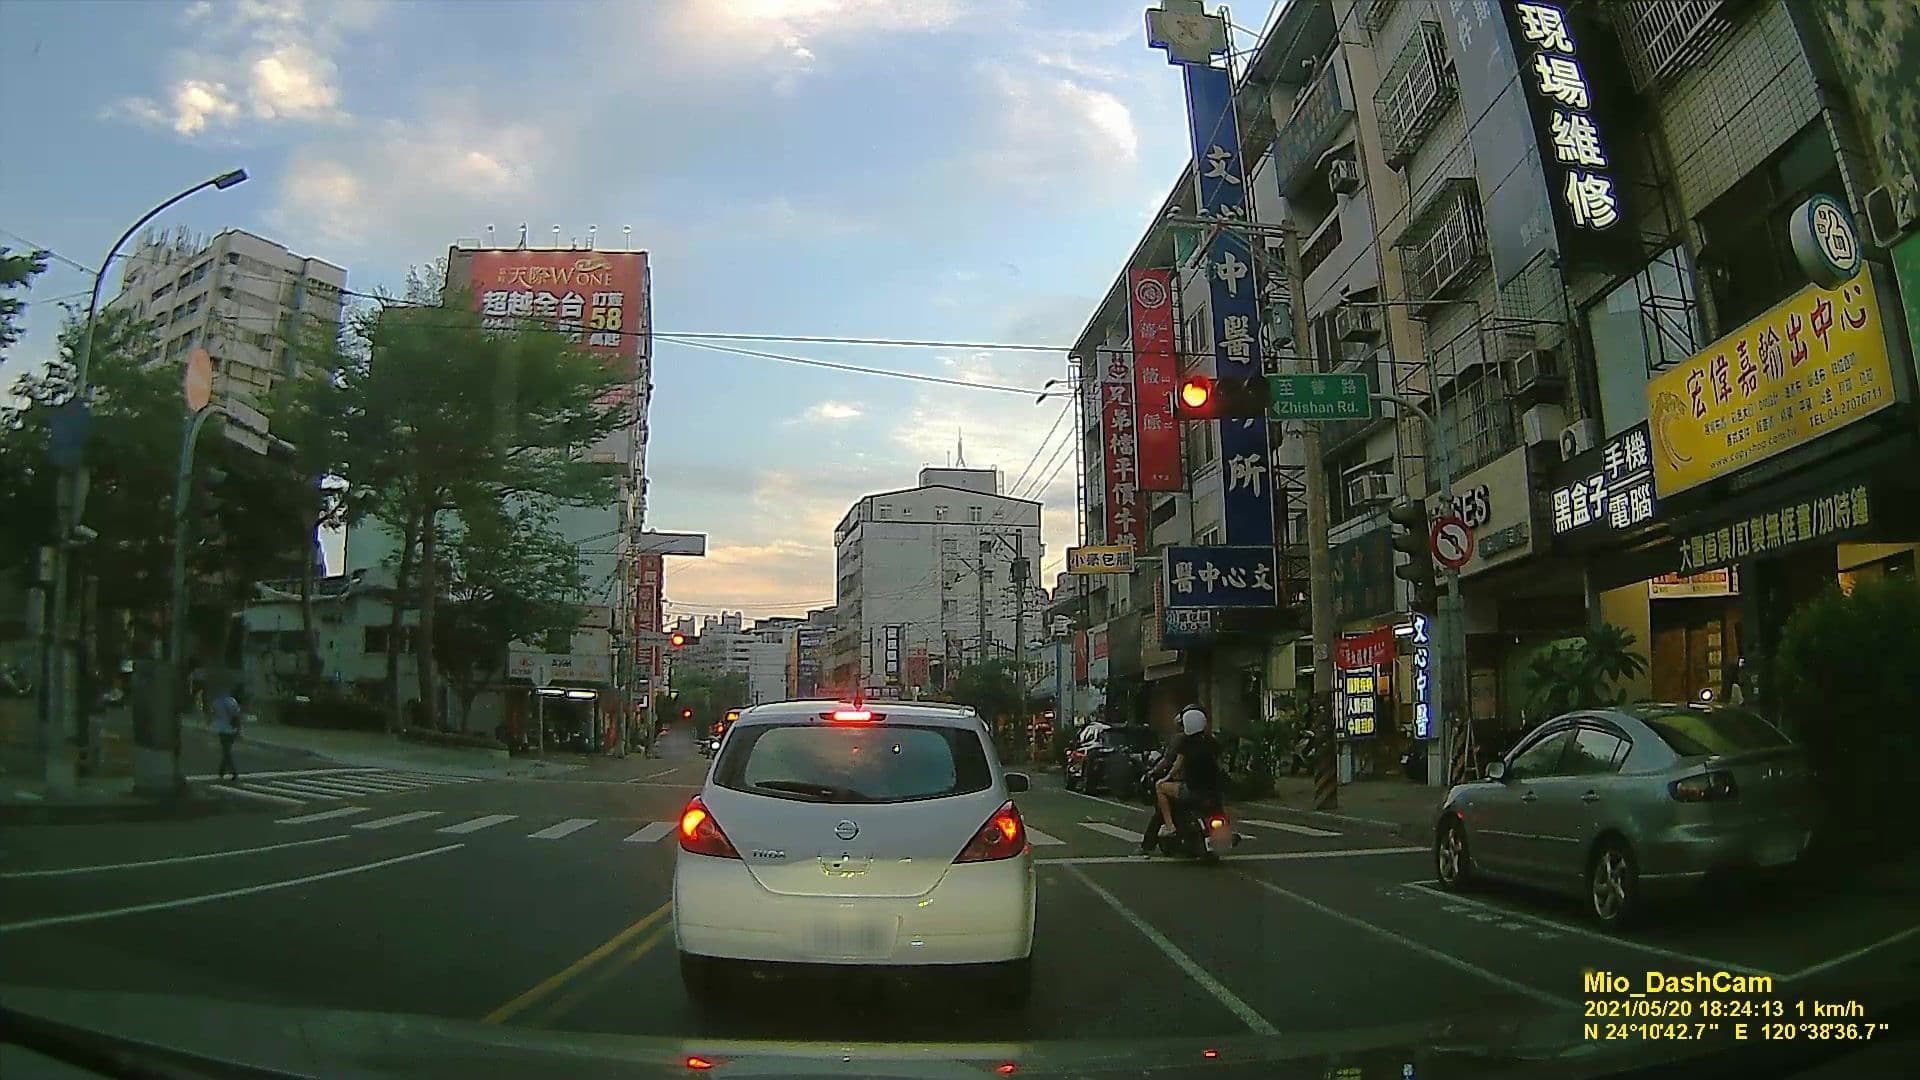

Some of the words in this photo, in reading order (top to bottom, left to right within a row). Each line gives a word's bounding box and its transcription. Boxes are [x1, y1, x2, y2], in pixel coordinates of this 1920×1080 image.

[1517, 2, 1619, 228] 現場維修
[483, 290, 584, 317] 超越全台
[590, 308, 623, 331] 58
[1204, 144, 1267, 498] 文心中醫所
[1686, 284, 1868, 419] 宏偉嘉輸出中心
[1278, 377, 1357, 396] 至善路
[1280, 400, 1334, 415] Zhishan
[1337, 399, 1359, 414] Rd.
[1603, 430, 1649, 480] 手機
[1552, 475, 1608, 534] 黑盒子
[1607, 482, 1653, 530] 電腦
